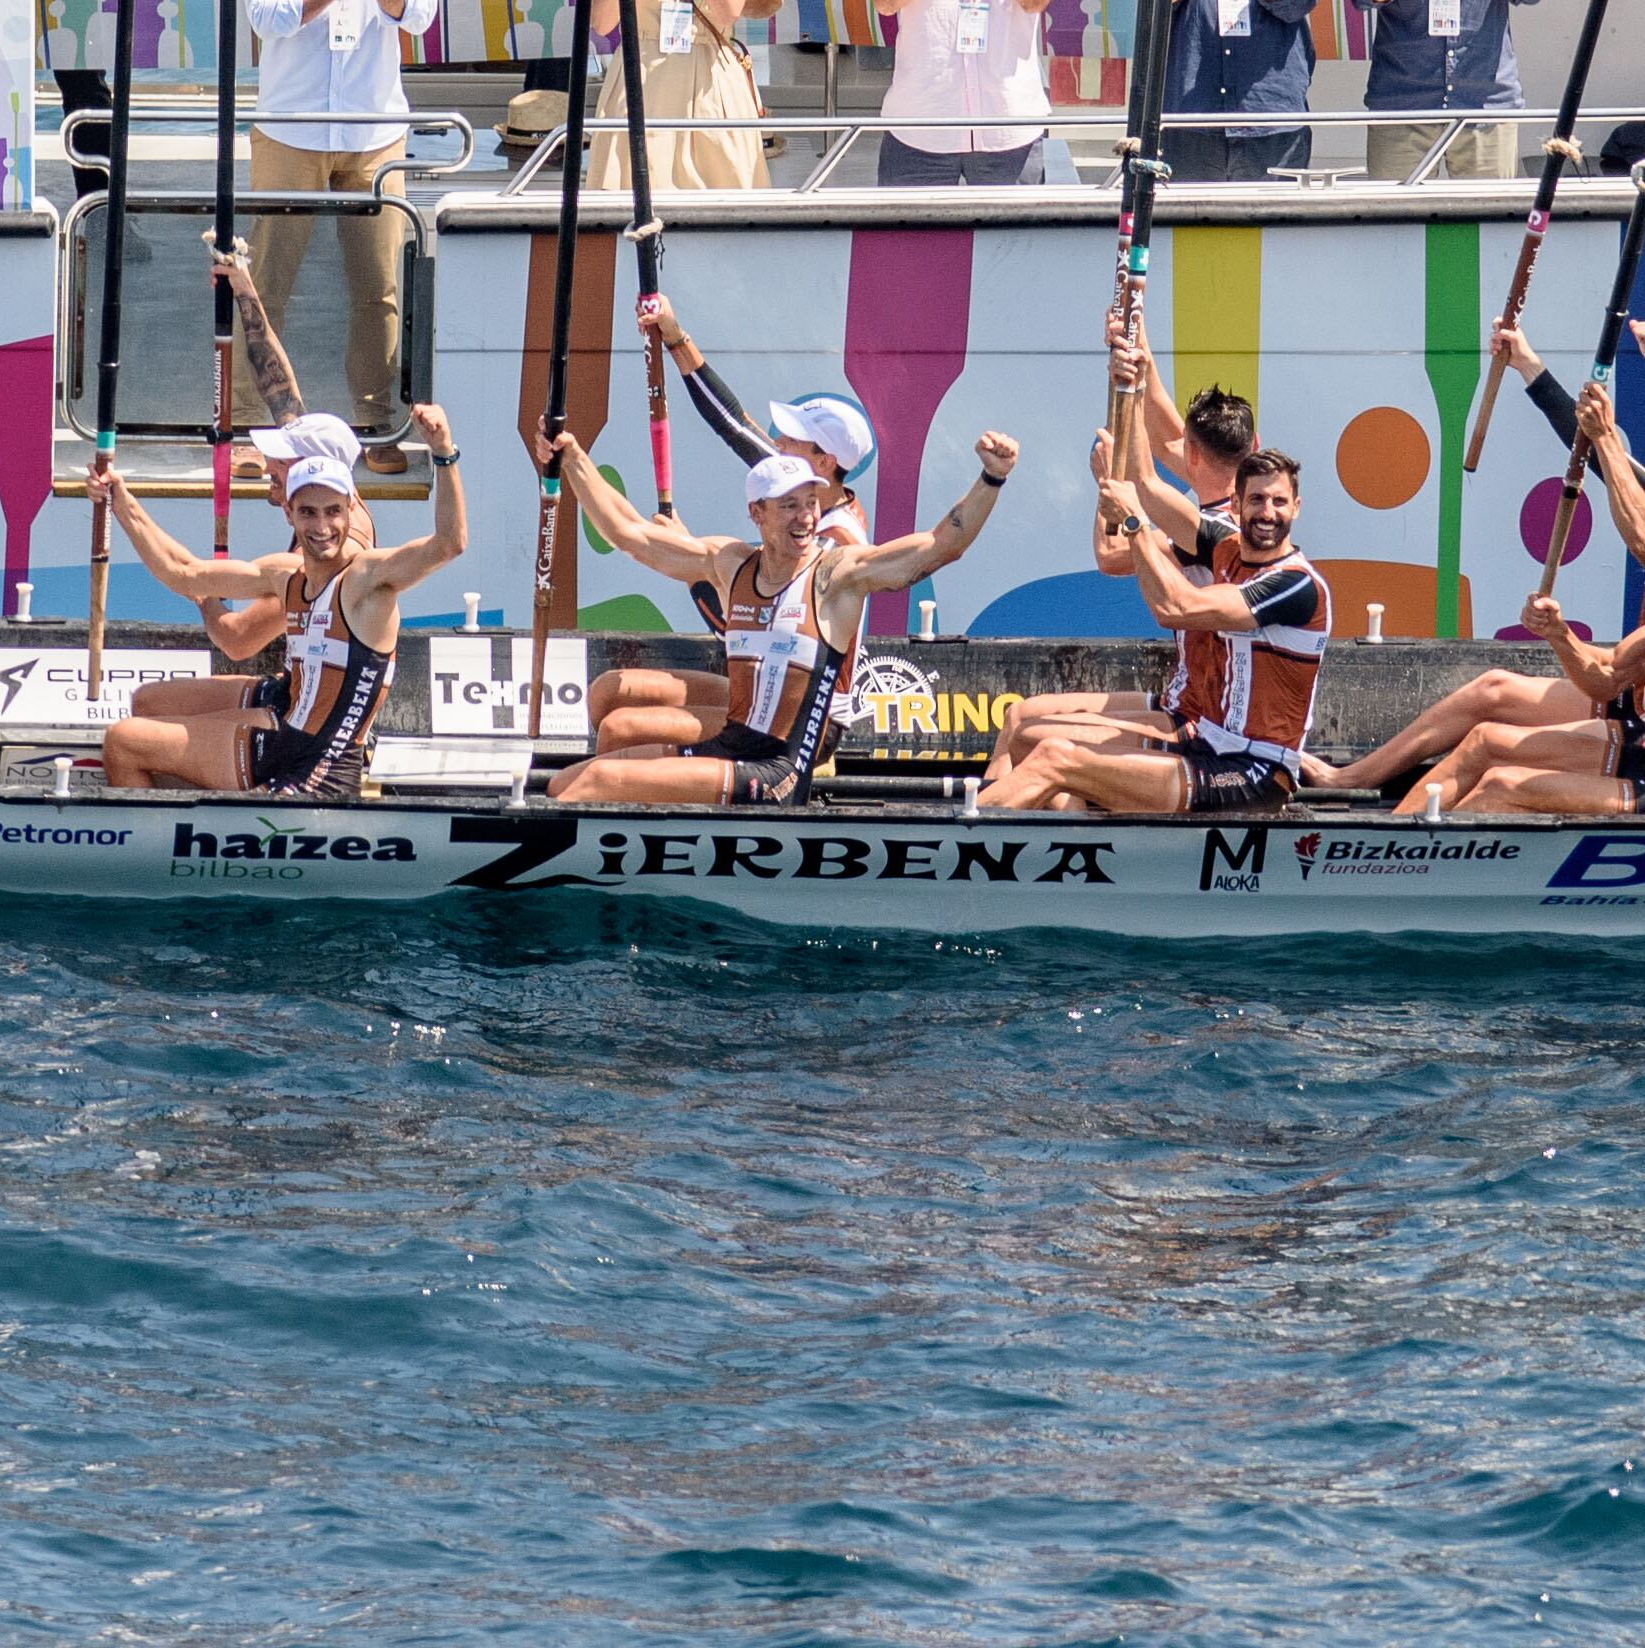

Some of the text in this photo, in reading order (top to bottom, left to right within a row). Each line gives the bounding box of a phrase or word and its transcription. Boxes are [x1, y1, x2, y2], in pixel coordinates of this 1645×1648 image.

[538, 506, 556, 572] CaixaBank
[172, 821, 418, 862] haizea
[1325, 839, 1521, 861] Bizkaialde
[170, 857, 305, 881] bilbao
[1321, 860, 1430, 876] fundazioa
[1539, 892, 1639, 907] Bahía
